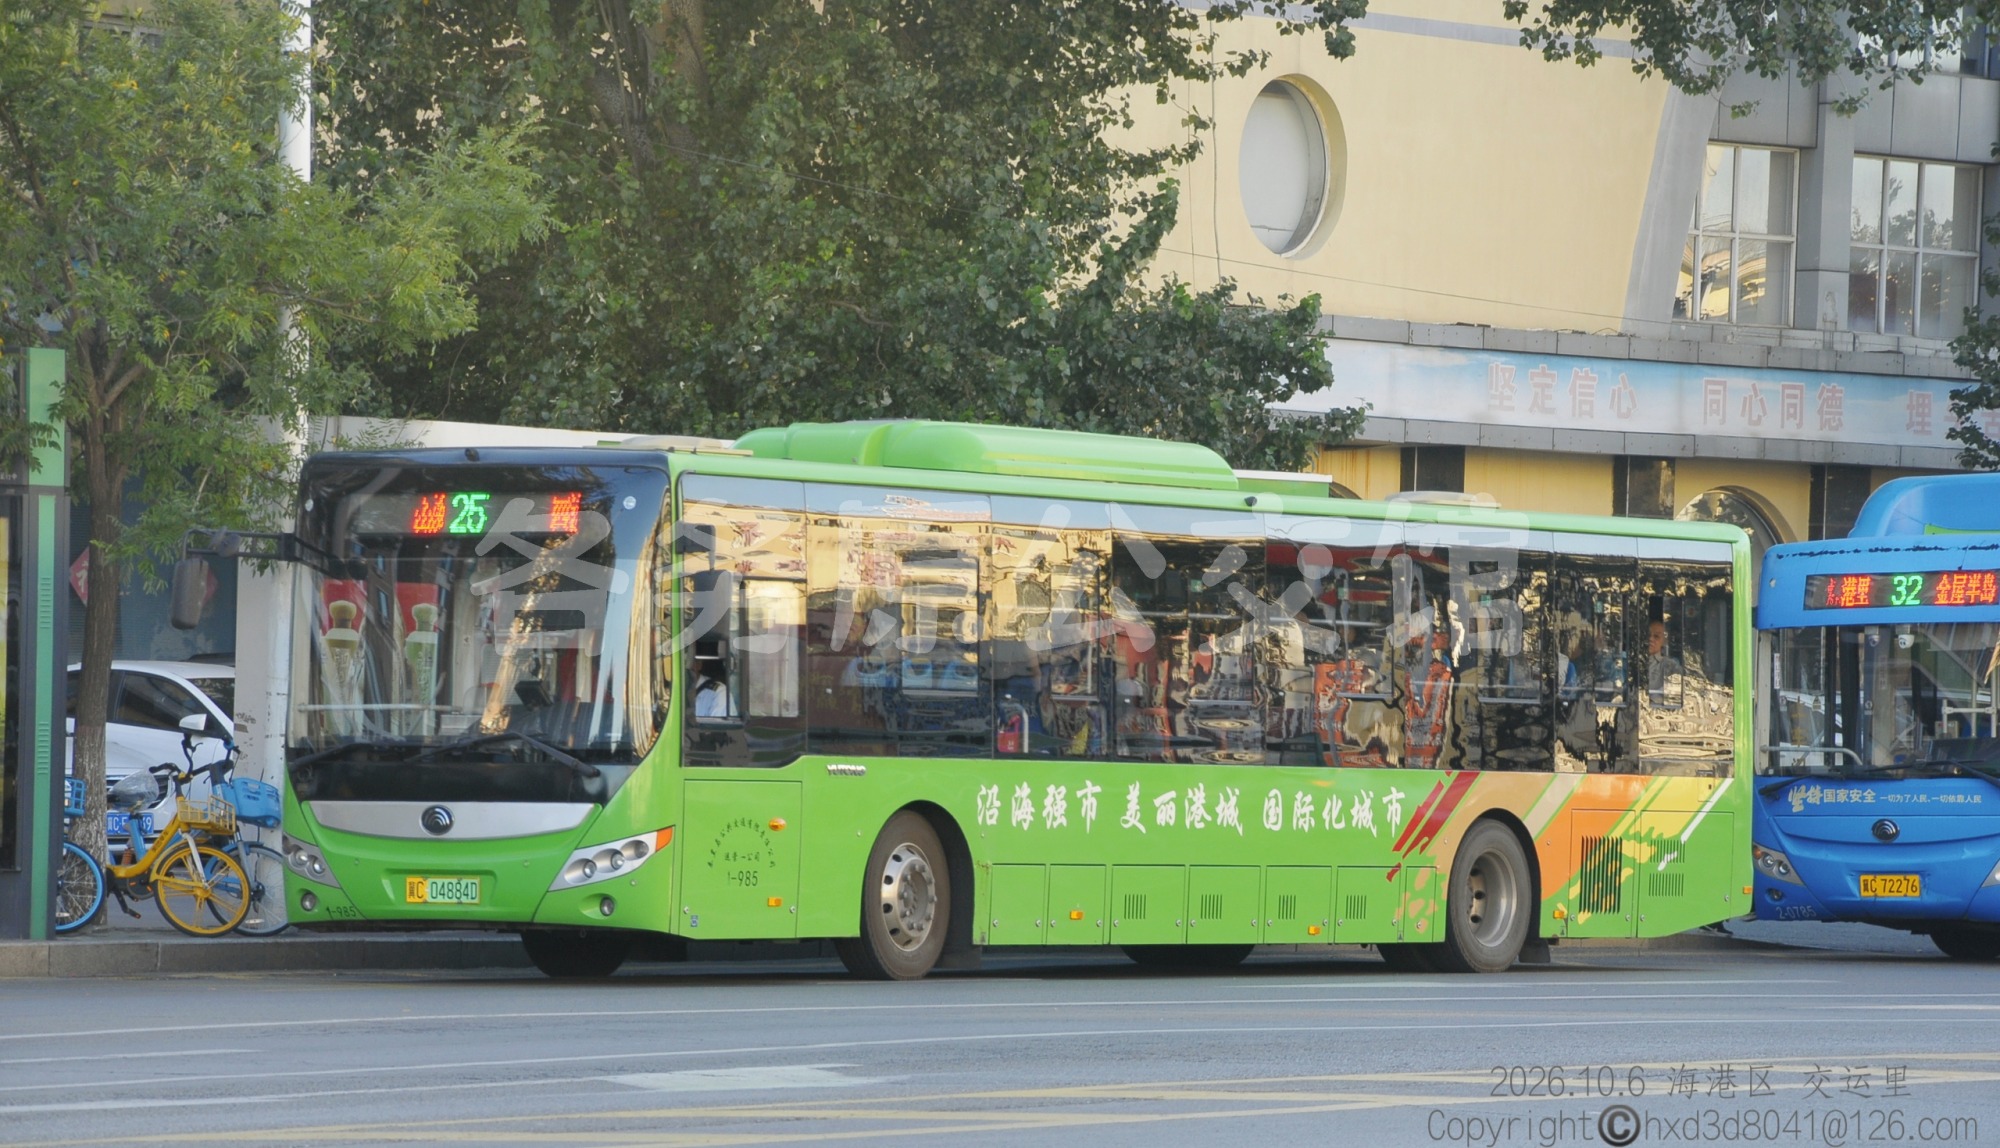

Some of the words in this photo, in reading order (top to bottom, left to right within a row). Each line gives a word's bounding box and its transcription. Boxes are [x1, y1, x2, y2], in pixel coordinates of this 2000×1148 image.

[1487, 363, 1638, 420] 坚定信心
[1702, 377, 1845, 432] 同心同德
[449, 494, 490, 533] 25
[1891, 575, 1923, 606] 32
[1934, 573, 1996, 605] 金屋半岛
[977, 780, 1102, 834] 沿海强市
[1120, 781, 1244, 837] 美丽港城
[1262, 786, 1406, 838] 国际化城市
[1788, 784, 1877, 813] 坚持国家安全
[727, 870, 759, 887] 1-985
[1882, 878, 1918, 894] 72276
[1775, 905, 1817, 920] 2-0785
